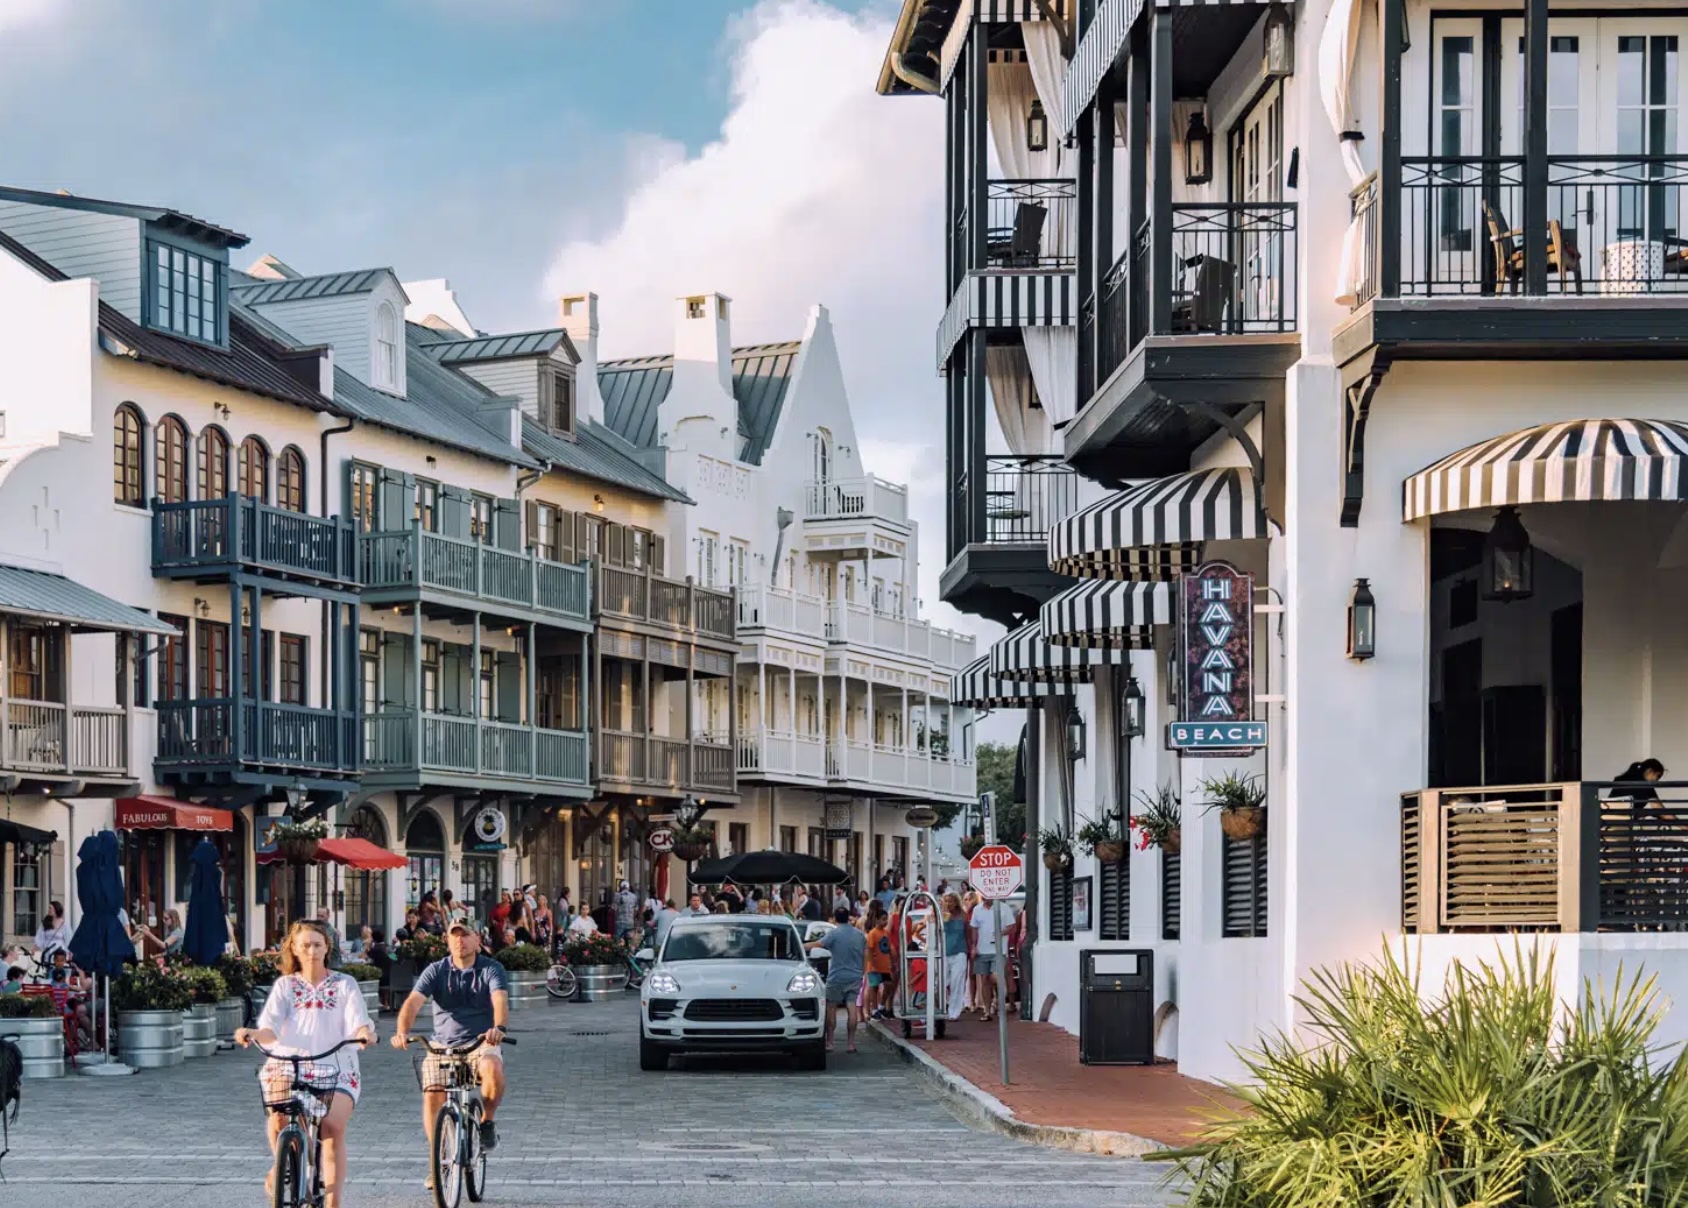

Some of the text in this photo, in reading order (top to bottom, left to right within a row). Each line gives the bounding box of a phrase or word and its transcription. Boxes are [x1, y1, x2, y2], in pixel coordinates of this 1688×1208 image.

[1201, 578, 1234, 715] HAVANA
[1176, 728, 1262, 740] BEACH
[122, 813, 213, 824] FABULOUS TOYS
[651, 833, 673, 846] CK
[980, 851, 1012, 867] STOP
[995, 868, 1011, 877] NOT
[983, 877, 1010, 886] ENTER
